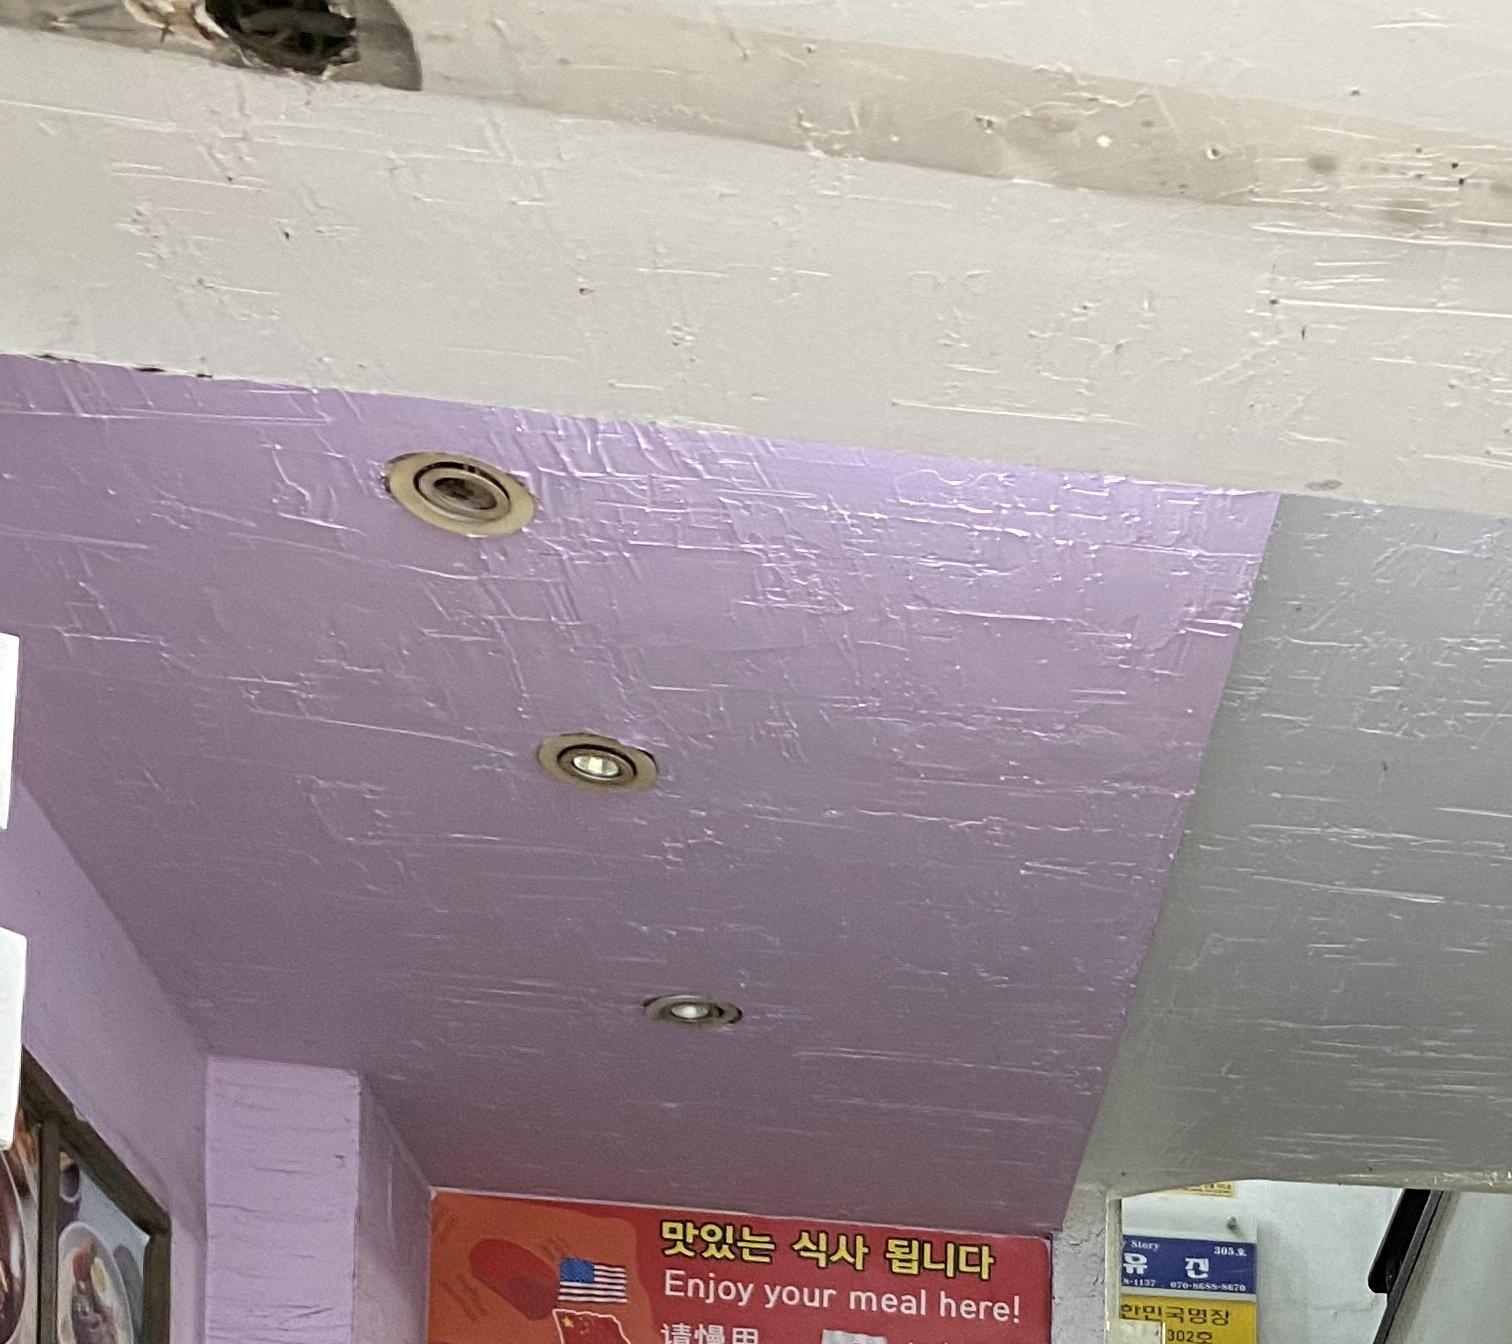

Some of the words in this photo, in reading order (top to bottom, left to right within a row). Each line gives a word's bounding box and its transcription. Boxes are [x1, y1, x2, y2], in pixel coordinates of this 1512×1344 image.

[659, 1219, 777, 1262] 맛있는
[790, 1230, 871, 1271] 식사
[885, 1238, 995, 1281] 됩니다
[663, 1271, 753, 1304] Enjoy
[763, 1282, 839, 1311] your
[848, 1286, 928, 1318] meal
[938, 1289, 1022, 1324] here!
